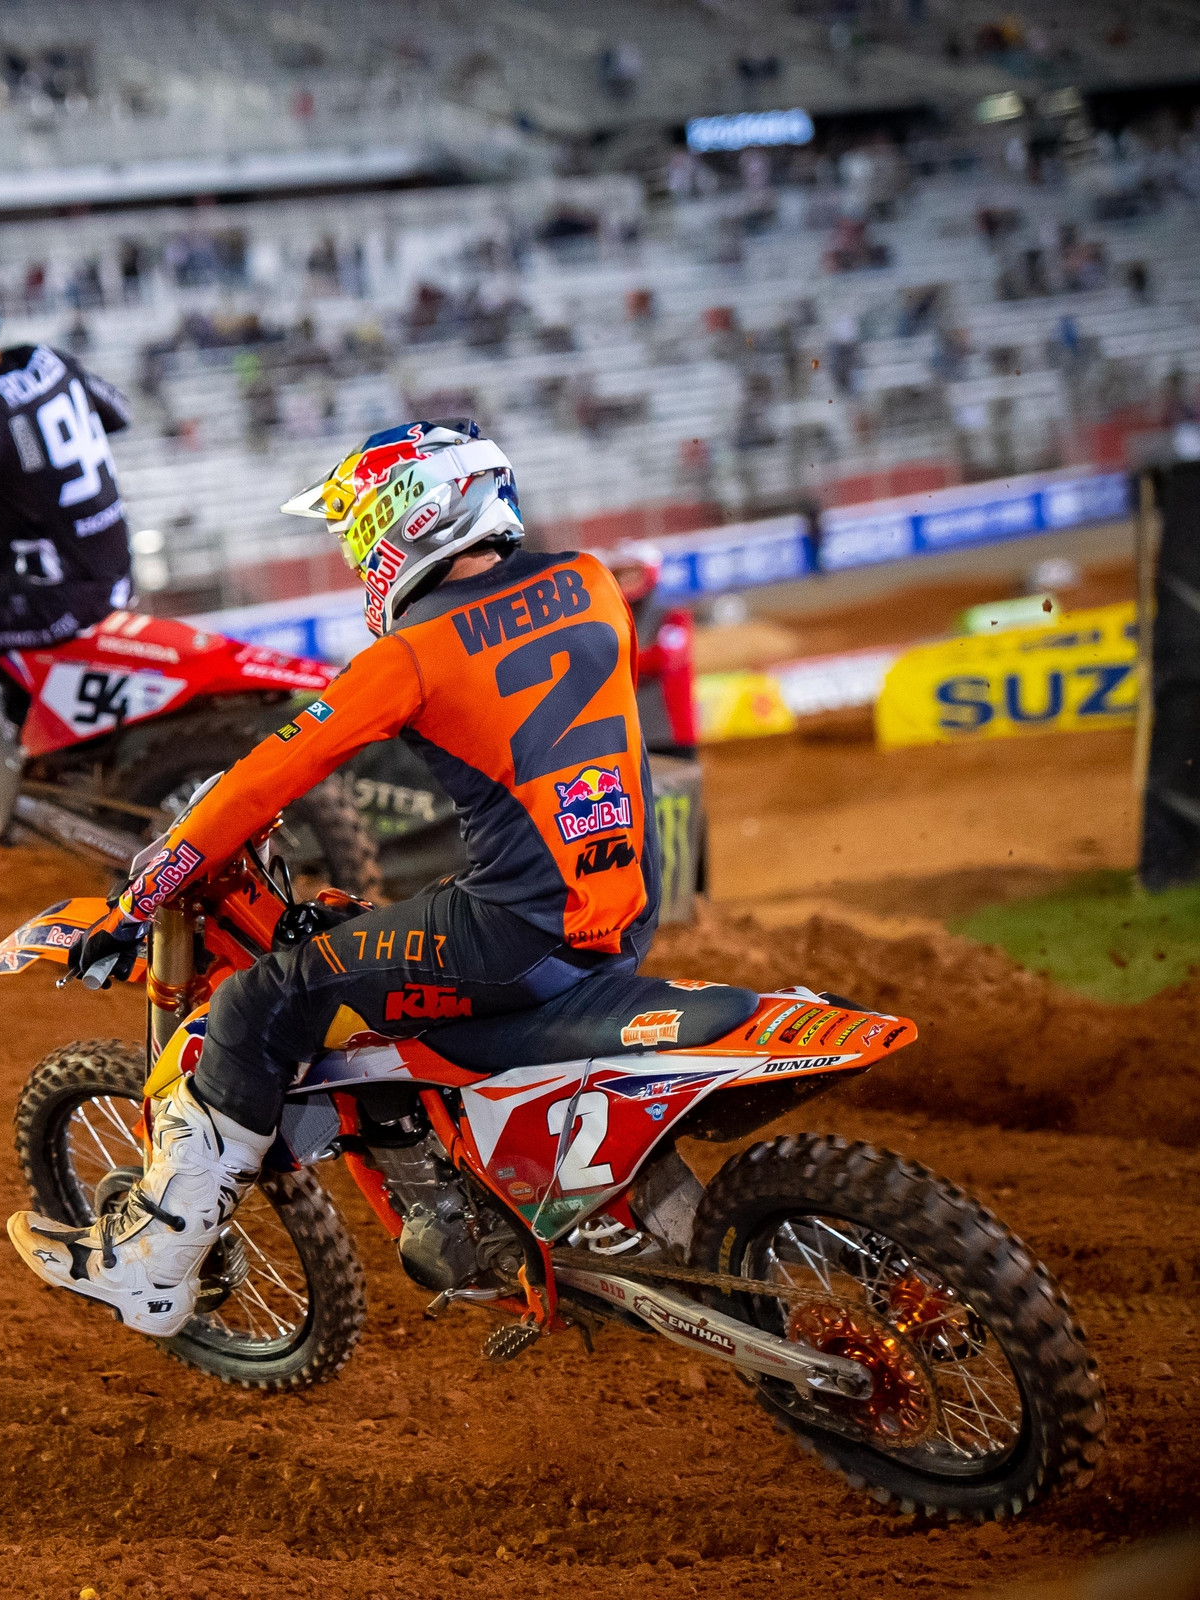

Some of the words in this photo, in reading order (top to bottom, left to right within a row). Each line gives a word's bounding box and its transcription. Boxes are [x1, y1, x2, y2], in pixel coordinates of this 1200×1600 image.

[37, 378, 118, 508] 94
[352, 470, 425, 555] 100%
[406, 508, 438, 537] BELL
[367, 535, 408, 600] Bull
[451, 569, 592, 657] WEBB
[73, 671, 129, 724] 94
[494, 621, 628, 788] 2
[559, 804, 598, 842] Red
[600, 797, 631, 828] Bull
[138, 876, 174, 914] Red
[163, 844, 201, 885] Bull
[575, 835, 639, 881] KTM
[243, 882, 262, 906] 2
[46, 925, 81, 948] Red
[385, 982, 473, 1022] KTM
[629, 1012, 679, 1030] KTM
[762, 1056, 841, 1074] DUNLOP
[546, 1091, 615, 1192] 2
[147, 1301, 173, 1314] 10
